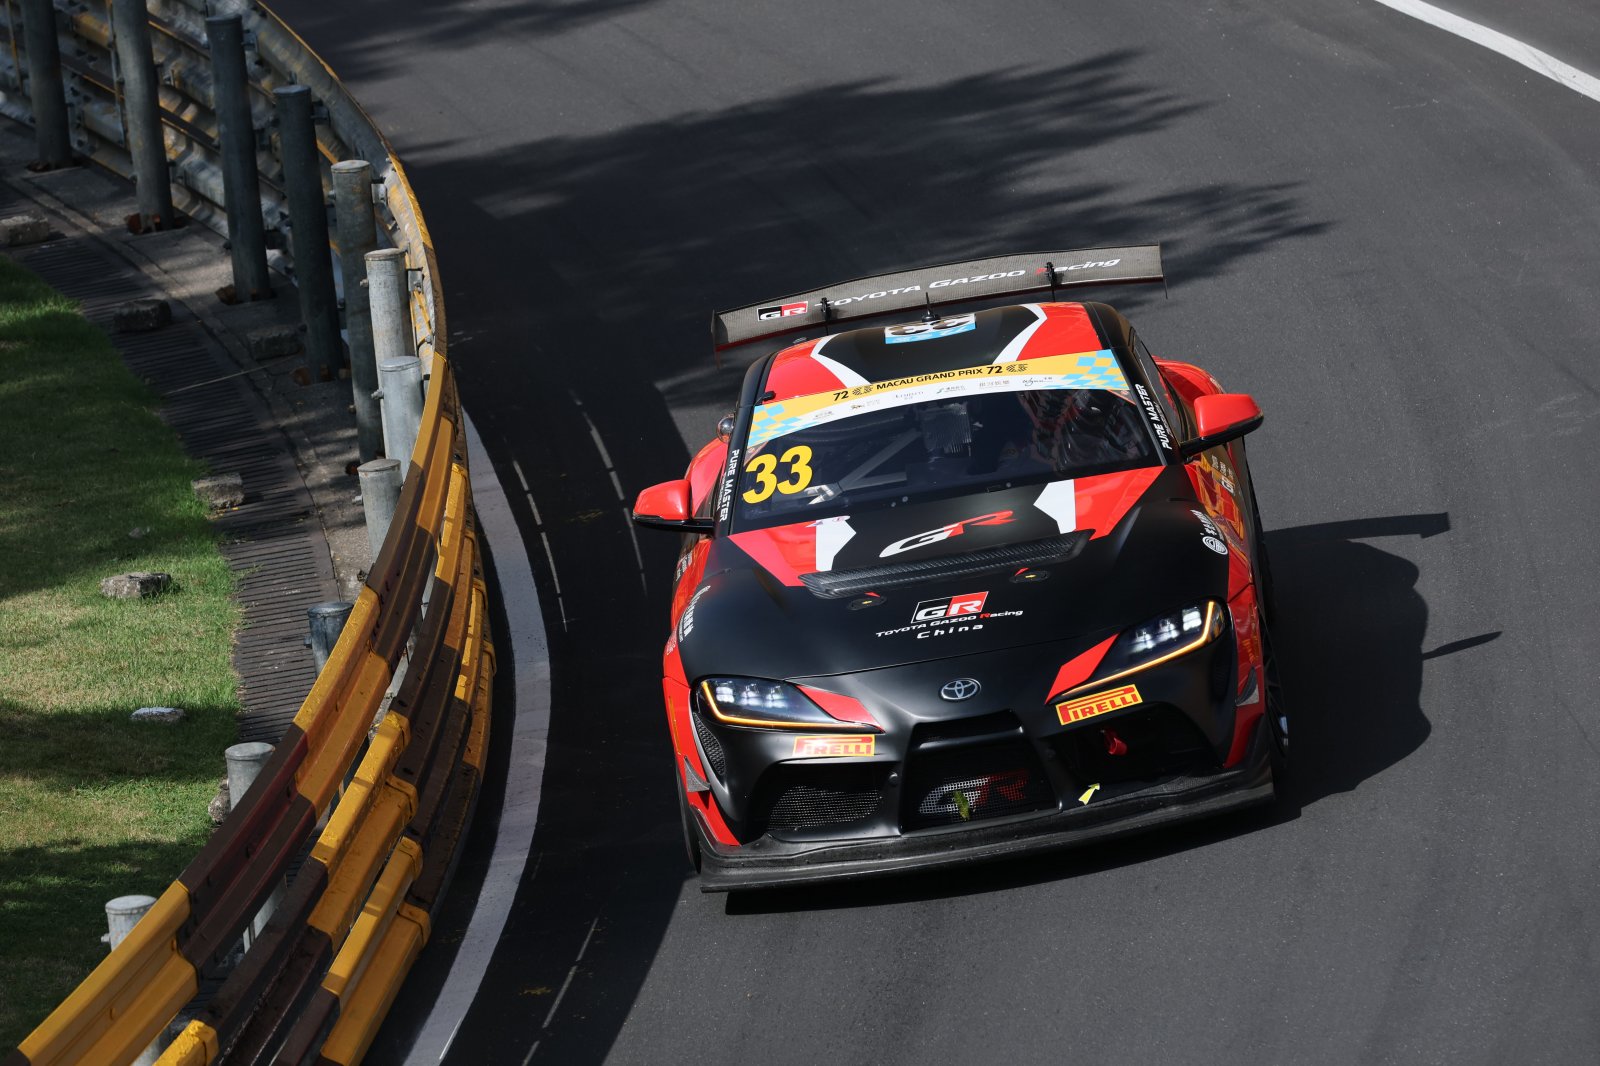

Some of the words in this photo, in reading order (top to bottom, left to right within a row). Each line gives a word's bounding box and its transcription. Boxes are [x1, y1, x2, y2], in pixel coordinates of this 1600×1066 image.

[929, 269, 1026, 289] GAZOO
[759, 307, 806, 320] GR
[833, 390, 850, 401] 72
[876, 377, 914, 390] MACAU
[916, 371, 956, 383] GRAND
[958, 368, 983, 376] PRIX
[987, 365, 1003, 374] 72
[1135, 384, 1160, 422] MASTER
[1153, 423, 1173, 450] PURE
[727, 449, 740, 477] PURE
[742, 445, 813, 504] 33
[719, 479, 734, 522] MASTER
[879, 510, 1017, 558] GR
[875, 623, 927, 637] TOYOTA
[929, 615, 977, 627] GAZOO
[979, 610, 1024, 619] Racing
[915, 599, 983, 621] GR
[917, 624, 984, 639] China
[1058, 687, 1139, 723] PIRELLI
[796, 736, 873, 755] PIRELLI
